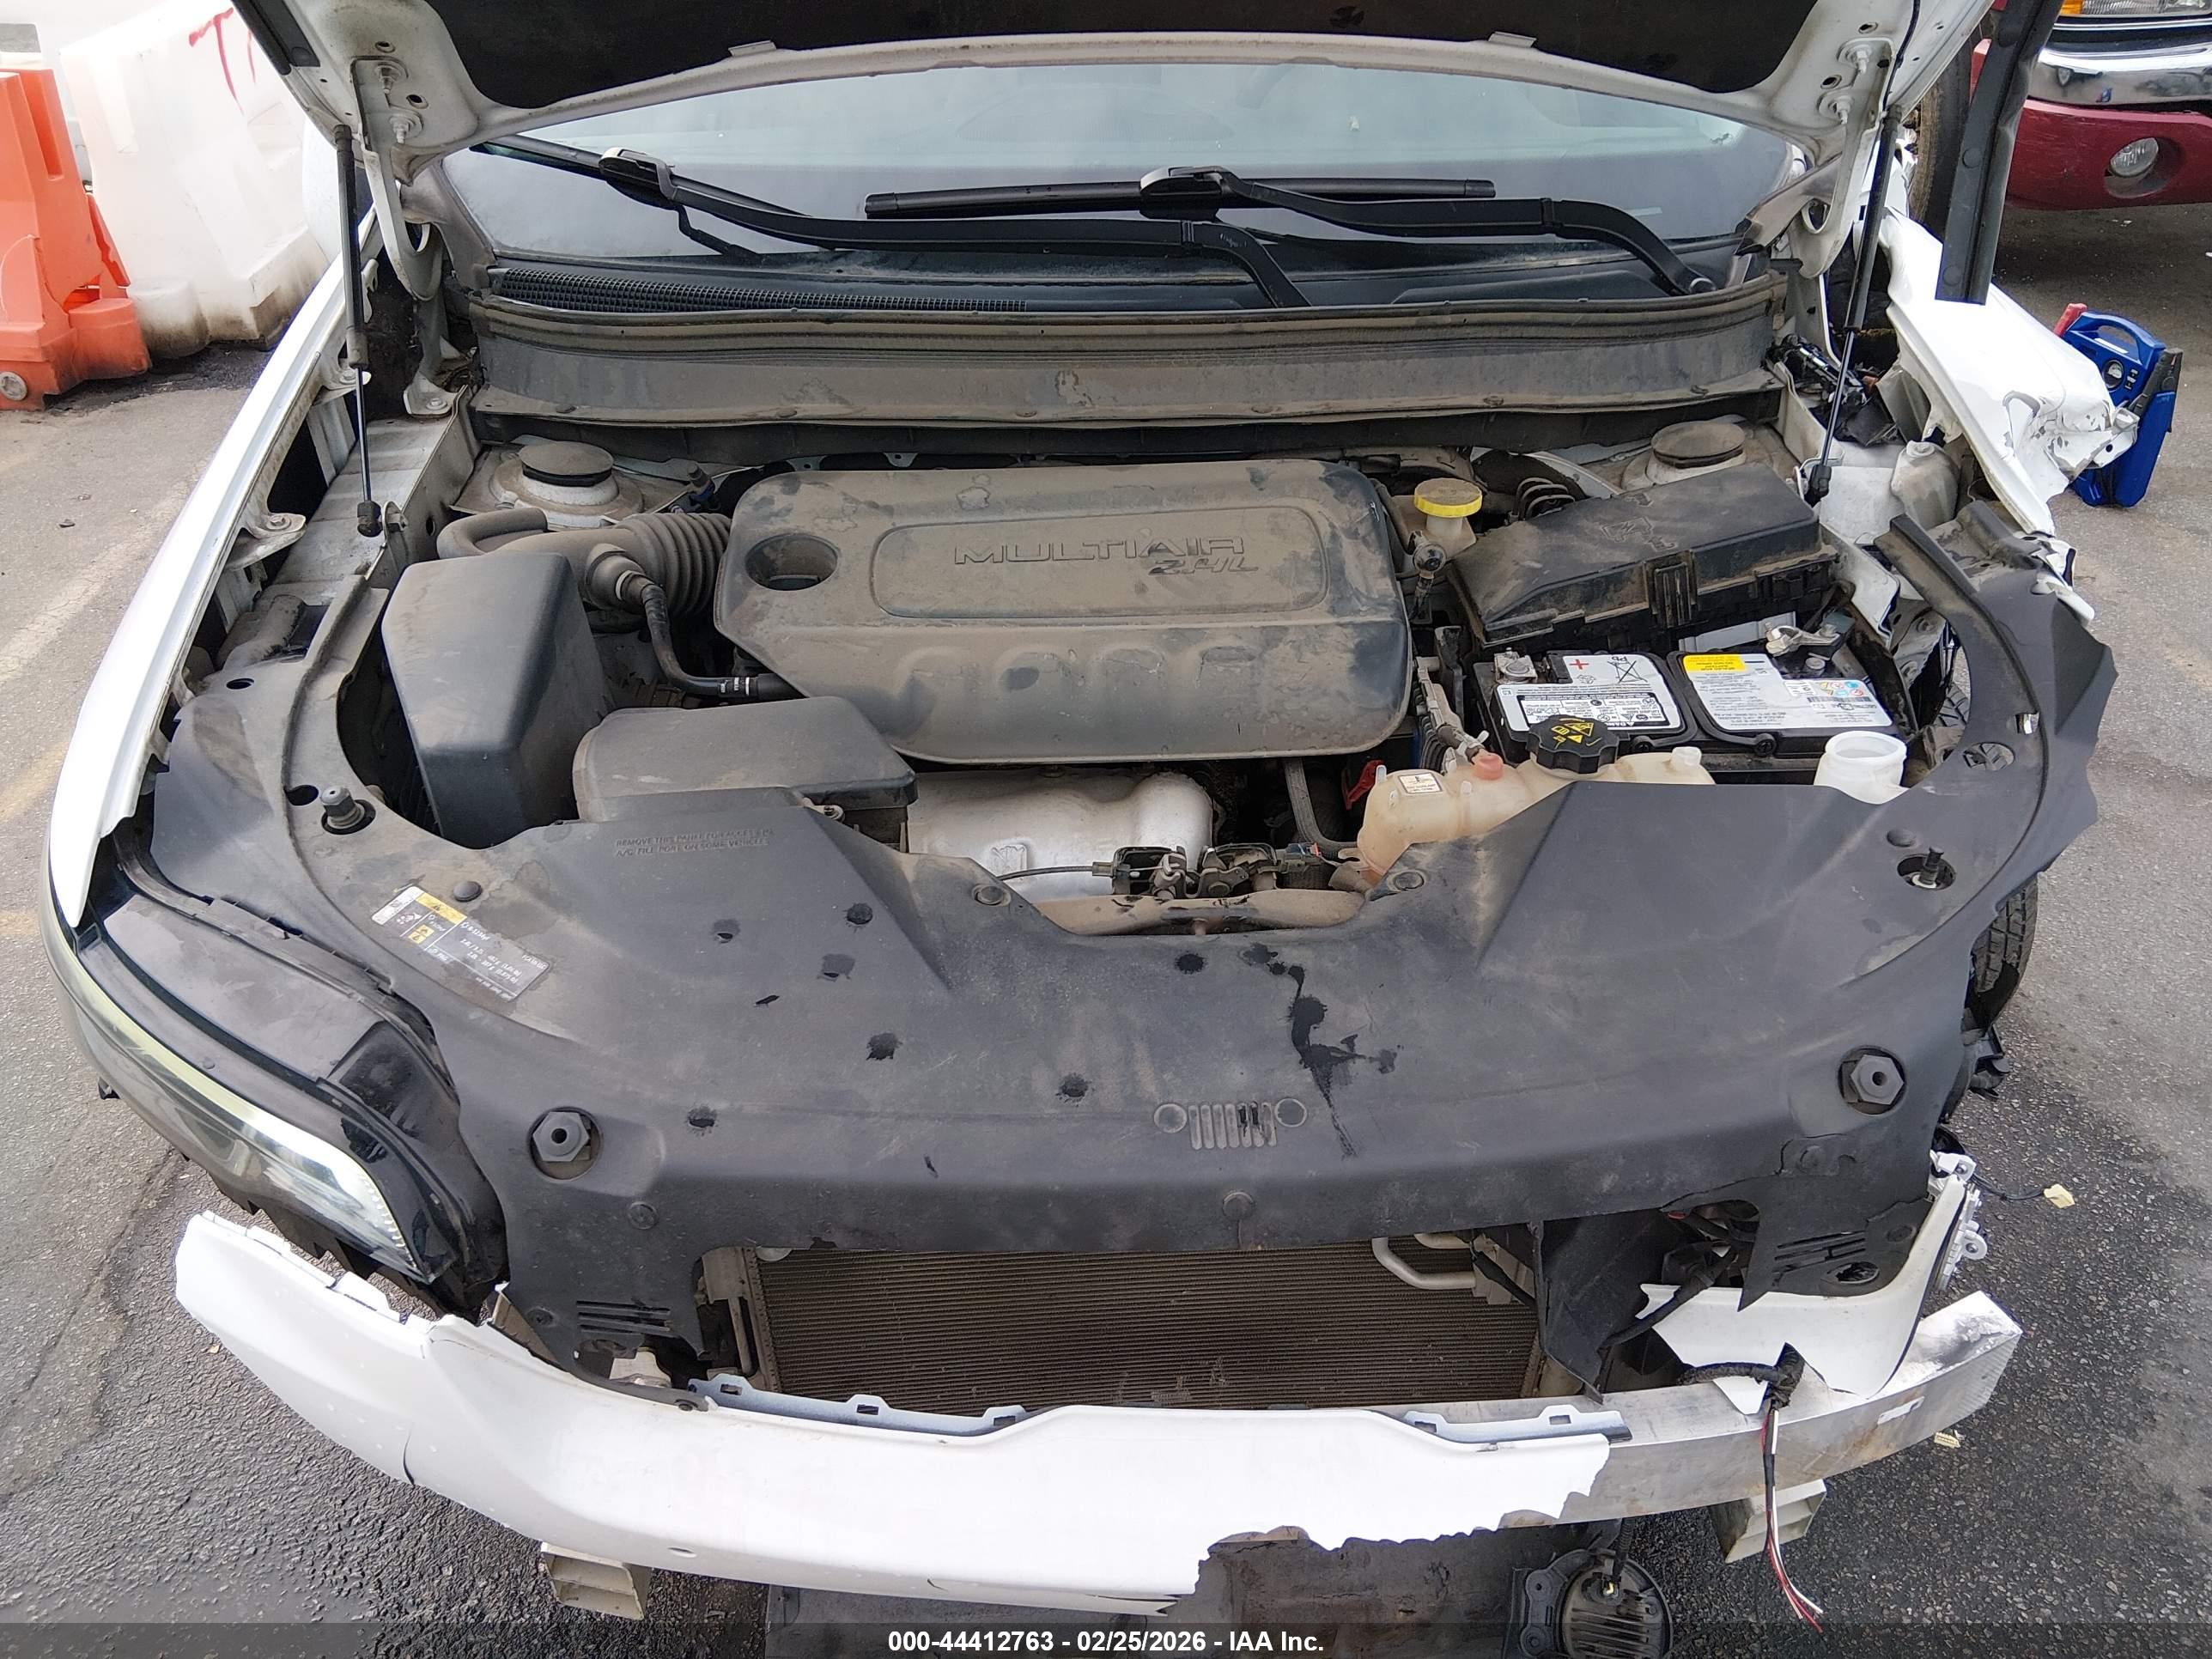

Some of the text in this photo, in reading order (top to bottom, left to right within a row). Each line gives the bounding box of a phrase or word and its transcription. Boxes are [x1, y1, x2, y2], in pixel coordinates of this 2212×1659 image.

[954, 536, 1245, 565] MULTIAIR
[617, 836, 653, 847] REMOVE
[656, 836, 672, 844] THIS
[658, 844, 681, 854] PORT
[728, 837, 770, 847] VEHICLES
